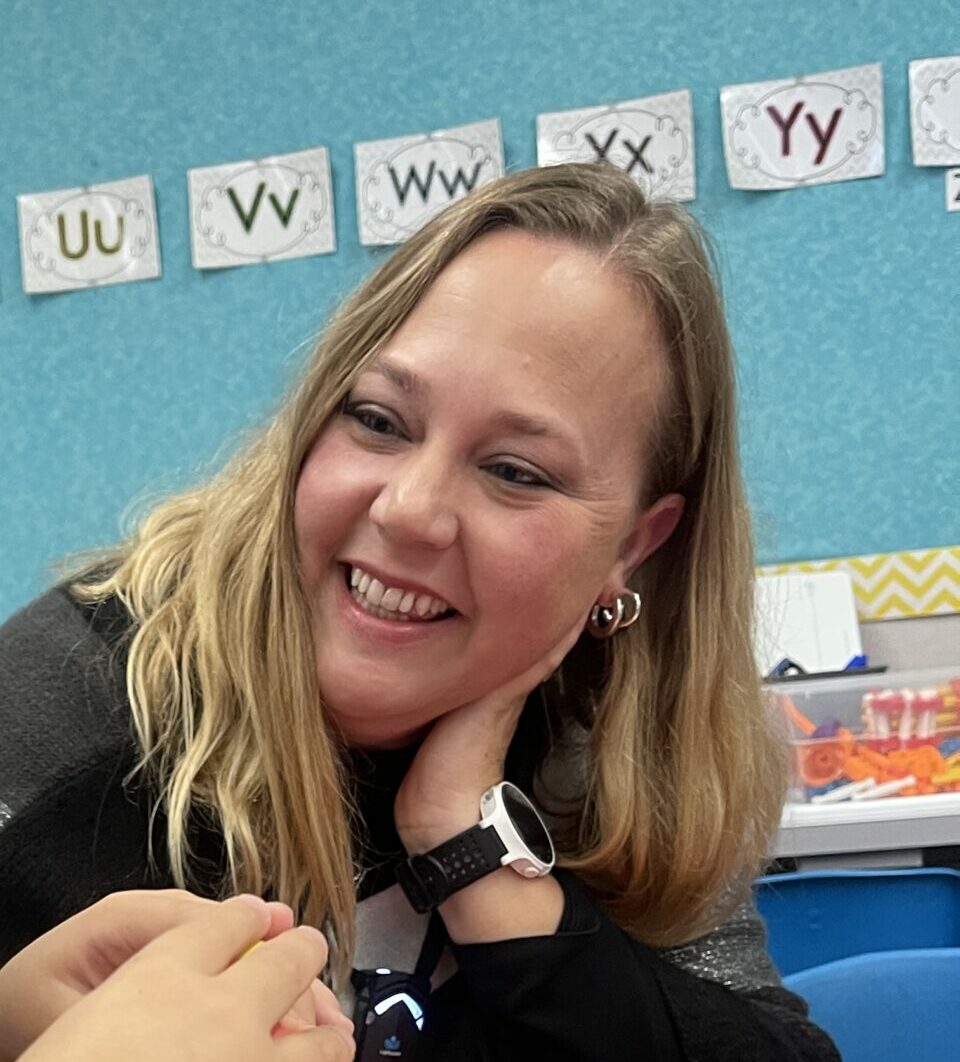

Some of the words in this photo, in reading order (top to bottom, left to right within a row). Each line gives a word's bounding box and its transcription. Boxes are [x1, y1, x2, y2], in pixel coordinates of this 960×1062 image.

[767, 101, 843, 166] Yy
[227, 181, 301, 234] Vv
[387, 159, 483, 204] Ww
[56, 208, 124, 261] Uu
